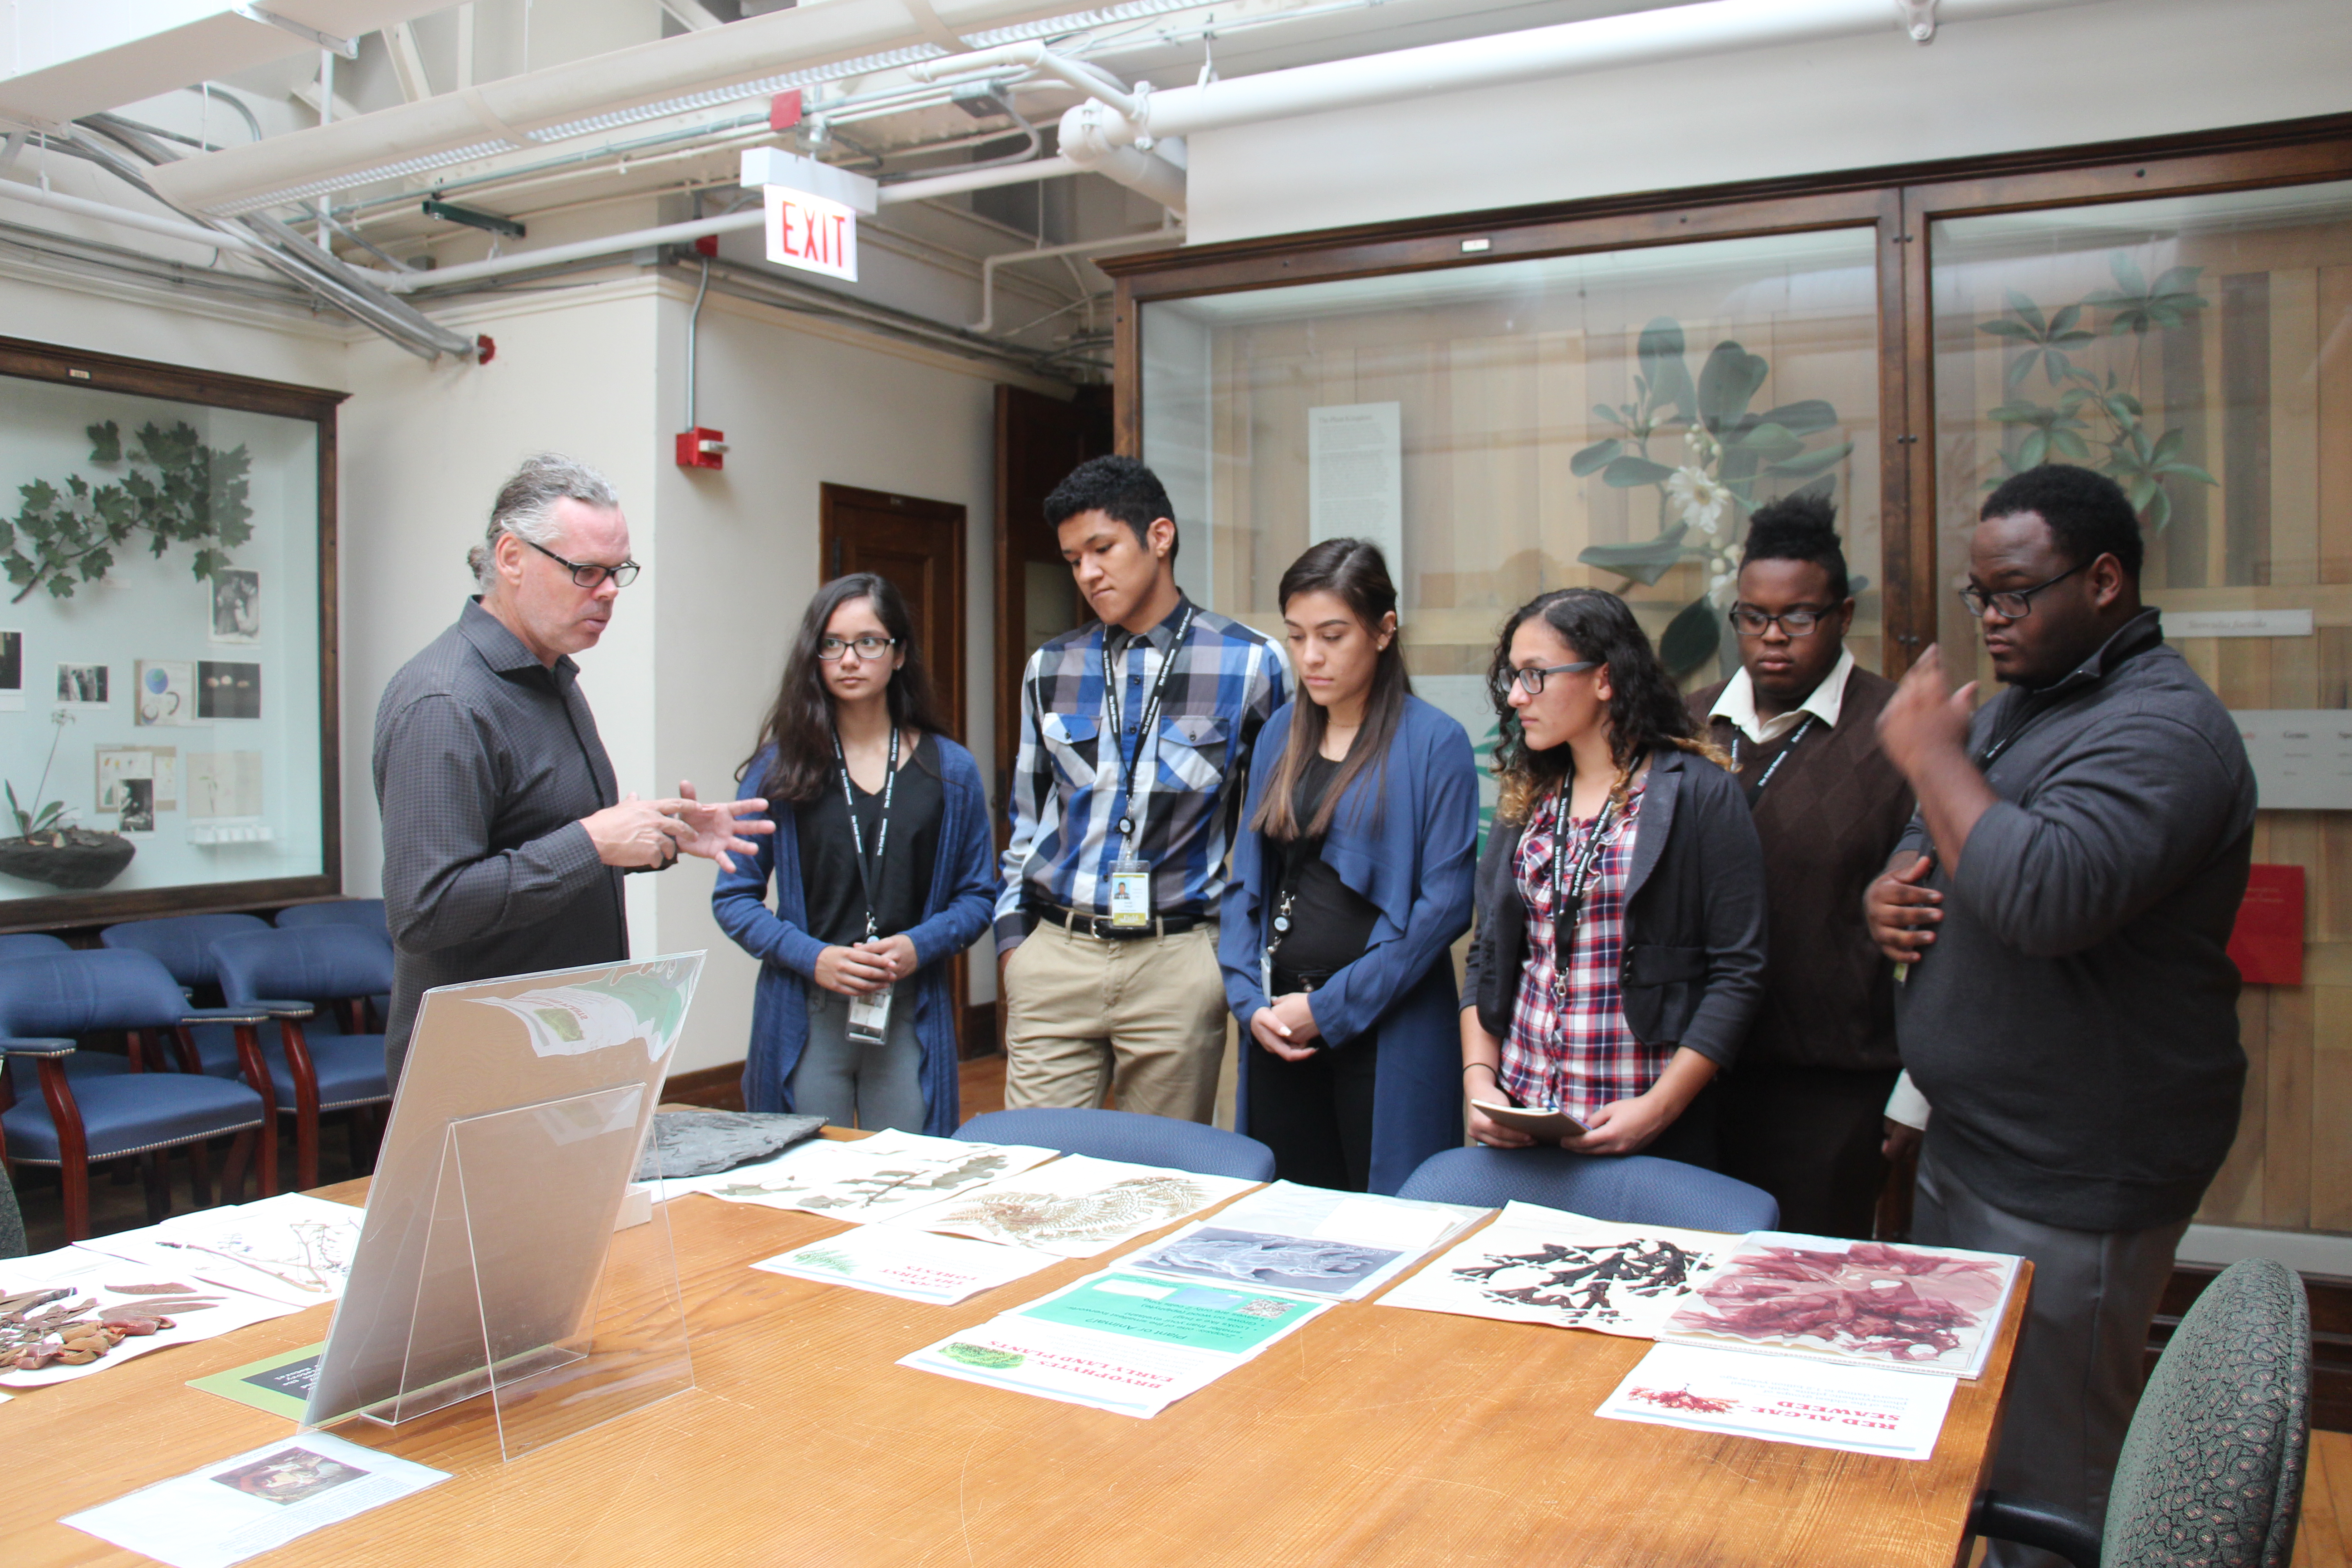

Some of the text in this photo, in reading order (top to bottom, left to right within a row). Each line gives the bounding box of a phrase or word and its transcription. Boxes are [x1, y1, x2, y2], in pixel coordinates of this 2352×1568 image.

[783, 200, 845, 268] EXIT
[1594, 820, 1603, 833] Field
[1574, 873, 1583, 886] Field
[1579, 852, 1589, 873] Museum
[879, 1269, 929, 1280] FIRST
[903, 1266, 979, 1280] FORESTS
[1085, 1318, 1137, 1330] Animal?
[1153, 1331, 1187, 1339] Plant
[988, 1341, 1175, 1382] EARLY LAND PLANTS
[1036, 1361, 1163, 1389] BRYOPHYTES
[1829, 1394, 1907, 1406] photosynthetic
[1750, 1406, 1836, 1422] ALGAE
[1777, 1401, 1901, 1421] SEAWEED
[1842, 1419, 1897, 1430] RED
